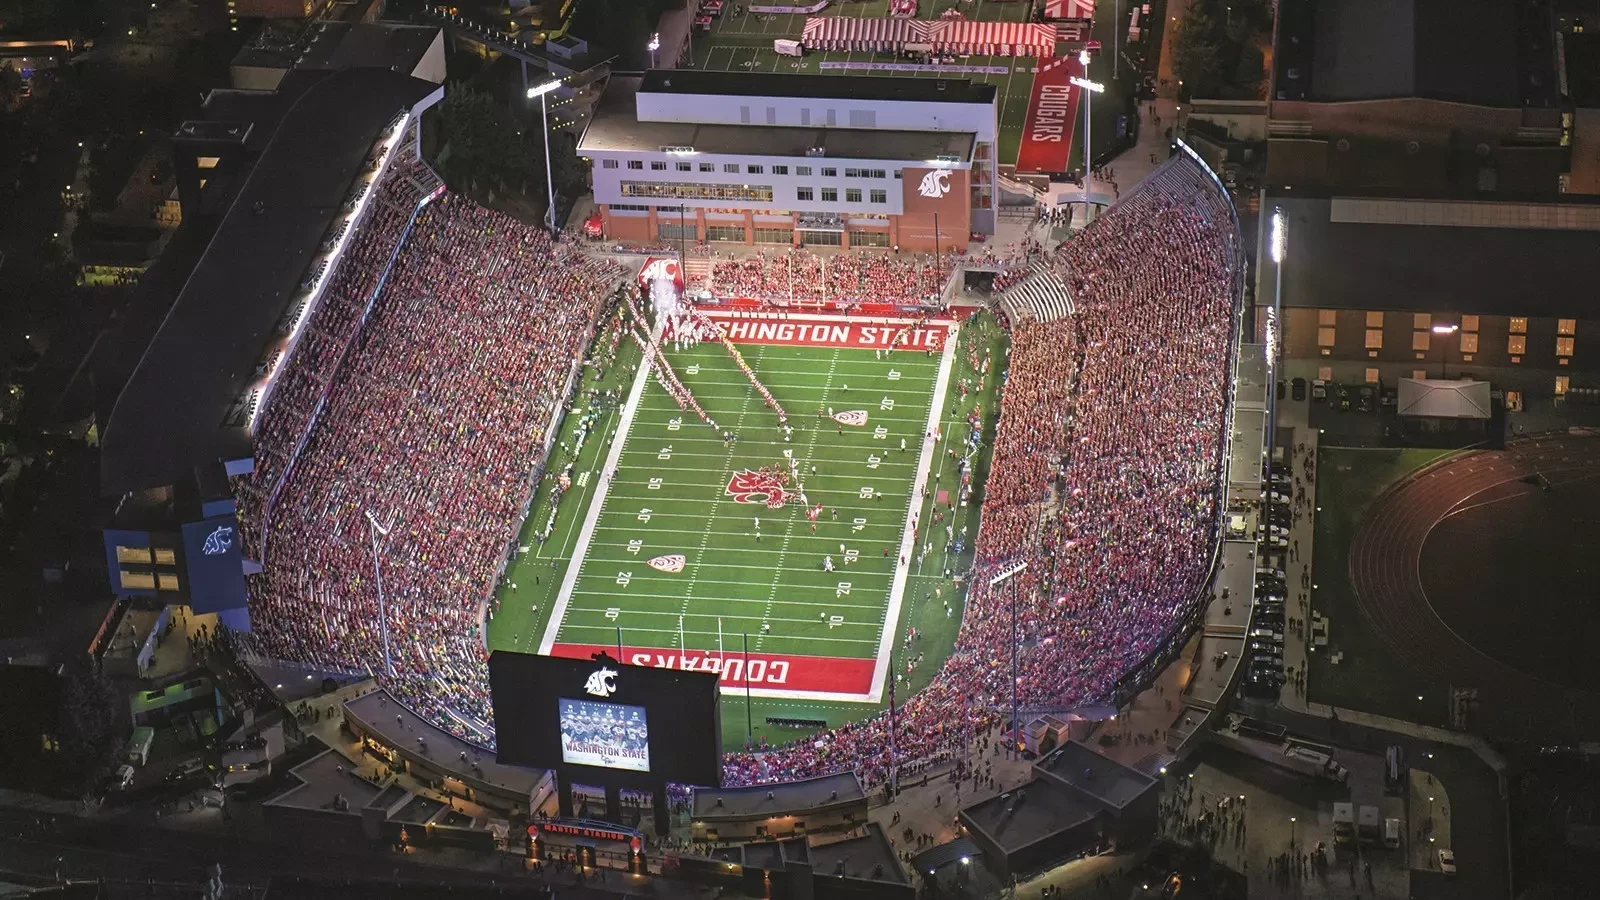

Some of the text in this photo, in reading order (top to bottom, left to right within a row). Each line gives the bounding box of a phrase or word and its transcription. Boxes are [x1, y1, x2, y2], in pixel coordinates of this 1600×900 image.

[1032, 85, 1071, 142] COUGARS
[859, 327, 942, 347] STATE
[686, 366, 700, 375] 10
[888, 371, 901, 381] 10
[880, 399, 895, 411] 20
[667, 419, 682, 431] 30
[873, 427, 888, 439] 30
[657, 448, 673, 459] 40
[866, 457, 881, 469] 40
[647, 478, 663, 490] 50
[859, 486, 874, 499] 50
[637, 508, 653, 520] 40
[852, 518, 867, 531] 40
[627, 539, 643, 552] 30
[844, 549, 859, 562] 30
[616, 571, 632, 584] 20
[836, 582, 852, 595] 20
[605, 607, 621, 618] 10
[829, 615, 844, 626] 10
[565, 742, 647, 760] WASHINGTON STATE
[544, 824, 625, 840] MARTIN STADIUM
